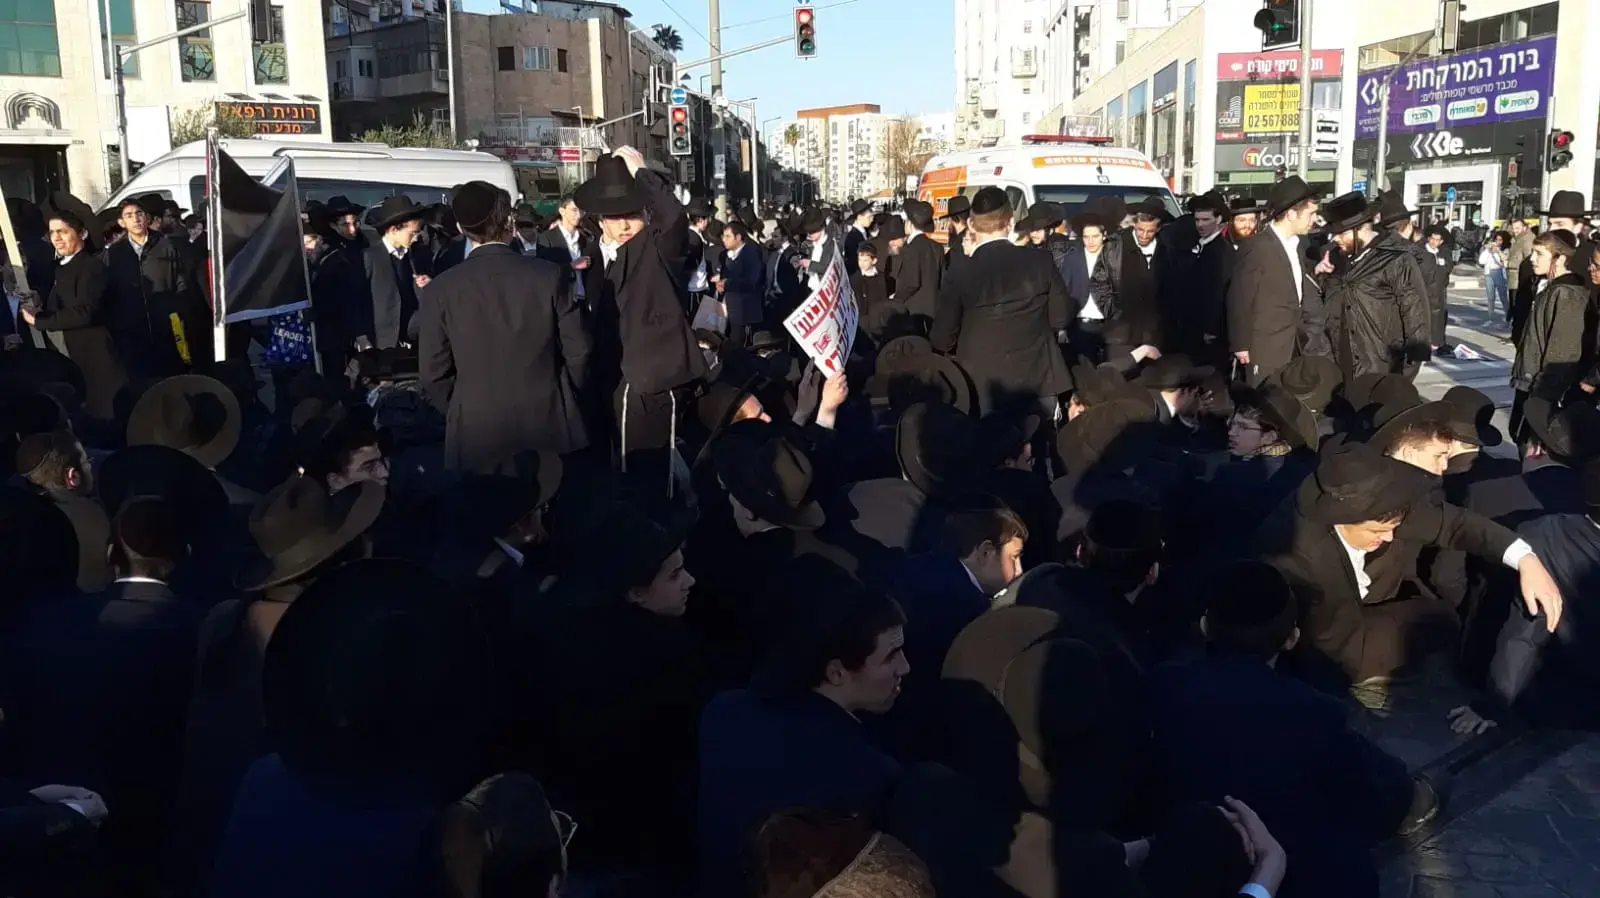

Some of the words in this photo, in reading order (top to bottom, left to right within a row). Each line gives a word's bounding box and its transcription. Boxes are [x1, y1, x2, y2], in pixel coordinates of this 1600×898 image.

[1499, 48, 1540, 75] בית
[1406, 57, 1492, 91] המרקחת
[1467, 83, 1494, 96] מרשמי
[1496, 79, 1517, 90] מכבד
[1444, 87, 1466, 99] קופות
[272, 106, 316, 119] רונית
[275, 123, 301, 133] מדע
